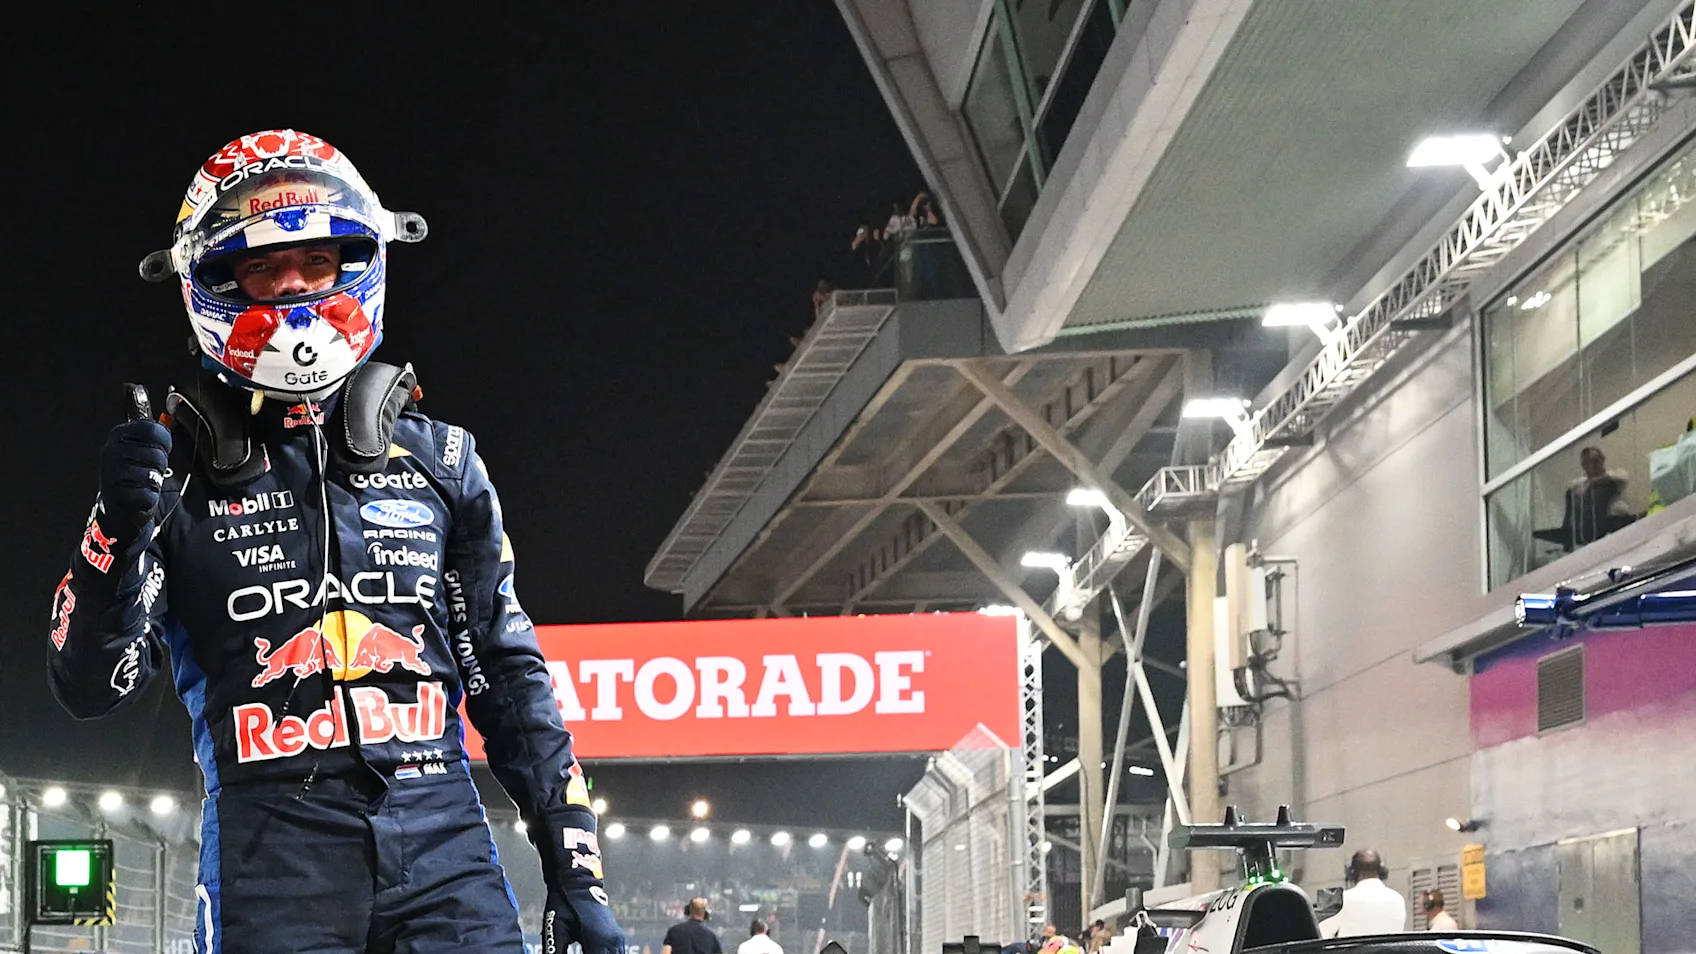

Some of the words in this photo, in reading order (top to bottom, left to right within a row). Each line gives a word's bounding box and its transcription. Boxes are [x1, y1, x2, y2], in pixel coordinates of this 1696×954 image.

[249, 194, 283, 216] Red
[227, 347, 255, 359] indeed
[284, 369, 329, 386] Gate
[369, 470, 428, 490] Gate
[208, 493, 270, 518] Mobil
[376, 503, 423, 524] Ford
[213, 517, 299, 542] CARLYLE
[363, 529, 437, 543] RACING
[232, 544, 285, 568] VISA
[259, 560, 297, 573] INFINITE
[367, 541, 439, 572] indeed
[227, 571, 438, 622] ORACLE
[444, 568, 468, 625] GIVES
[234, 686, 351, 764] Red
[349, 681, 447, 745] Bull
[424, 762, 448, 775] MAX
[545, 910, 556, 954] sparco
